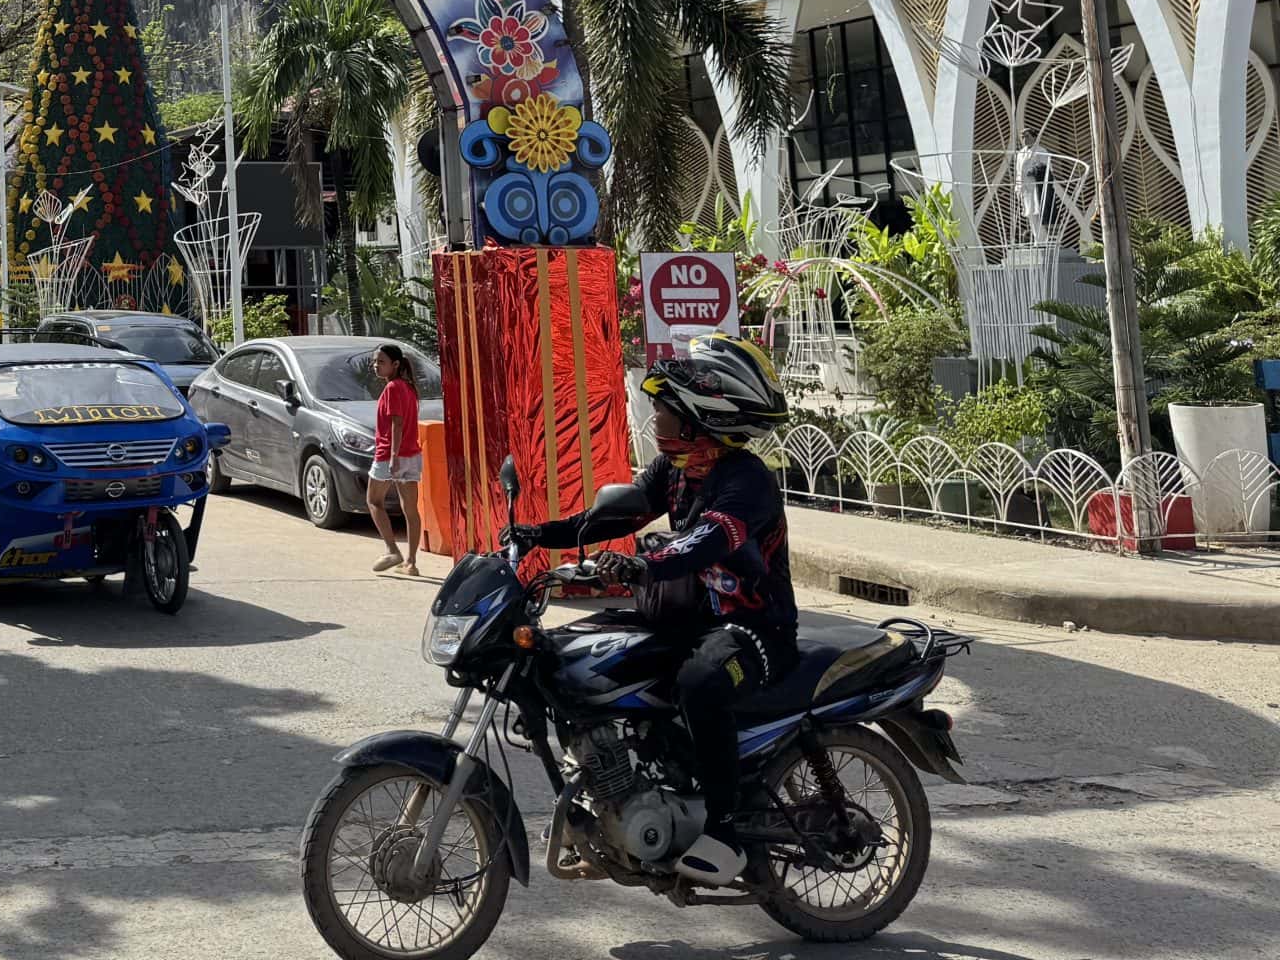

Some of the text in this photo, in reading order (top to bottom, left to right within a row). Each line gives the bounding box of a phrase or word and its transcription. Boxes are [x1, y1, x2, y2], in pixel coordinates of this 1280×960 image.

[670, 264, 707, 285] NO
[663, 302, 720, 319] ENTRY
[34, 404, 167, 424] MITCH
